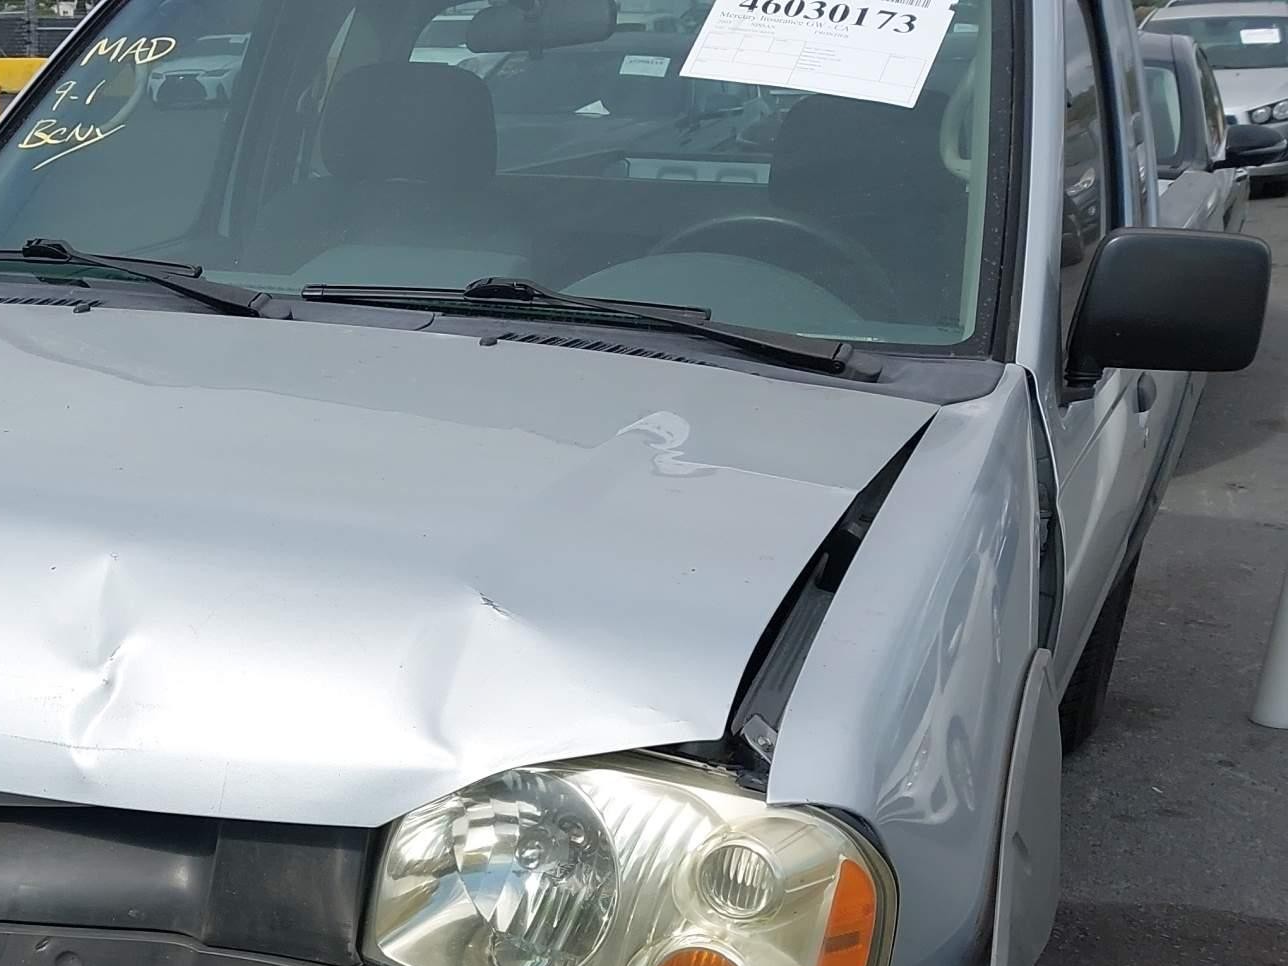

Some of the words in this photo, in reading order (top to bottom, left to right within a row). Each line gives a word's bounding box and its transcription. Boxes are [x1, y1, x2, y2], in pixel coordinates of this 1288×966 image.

[719, 11, 756, 21] Mercury
[759, 15, 804, 26] Insurance
[833, 24, 850, 32] CA
[738, 0, 918, 34] 46030173
[80, 36, 176, 66] MAD
